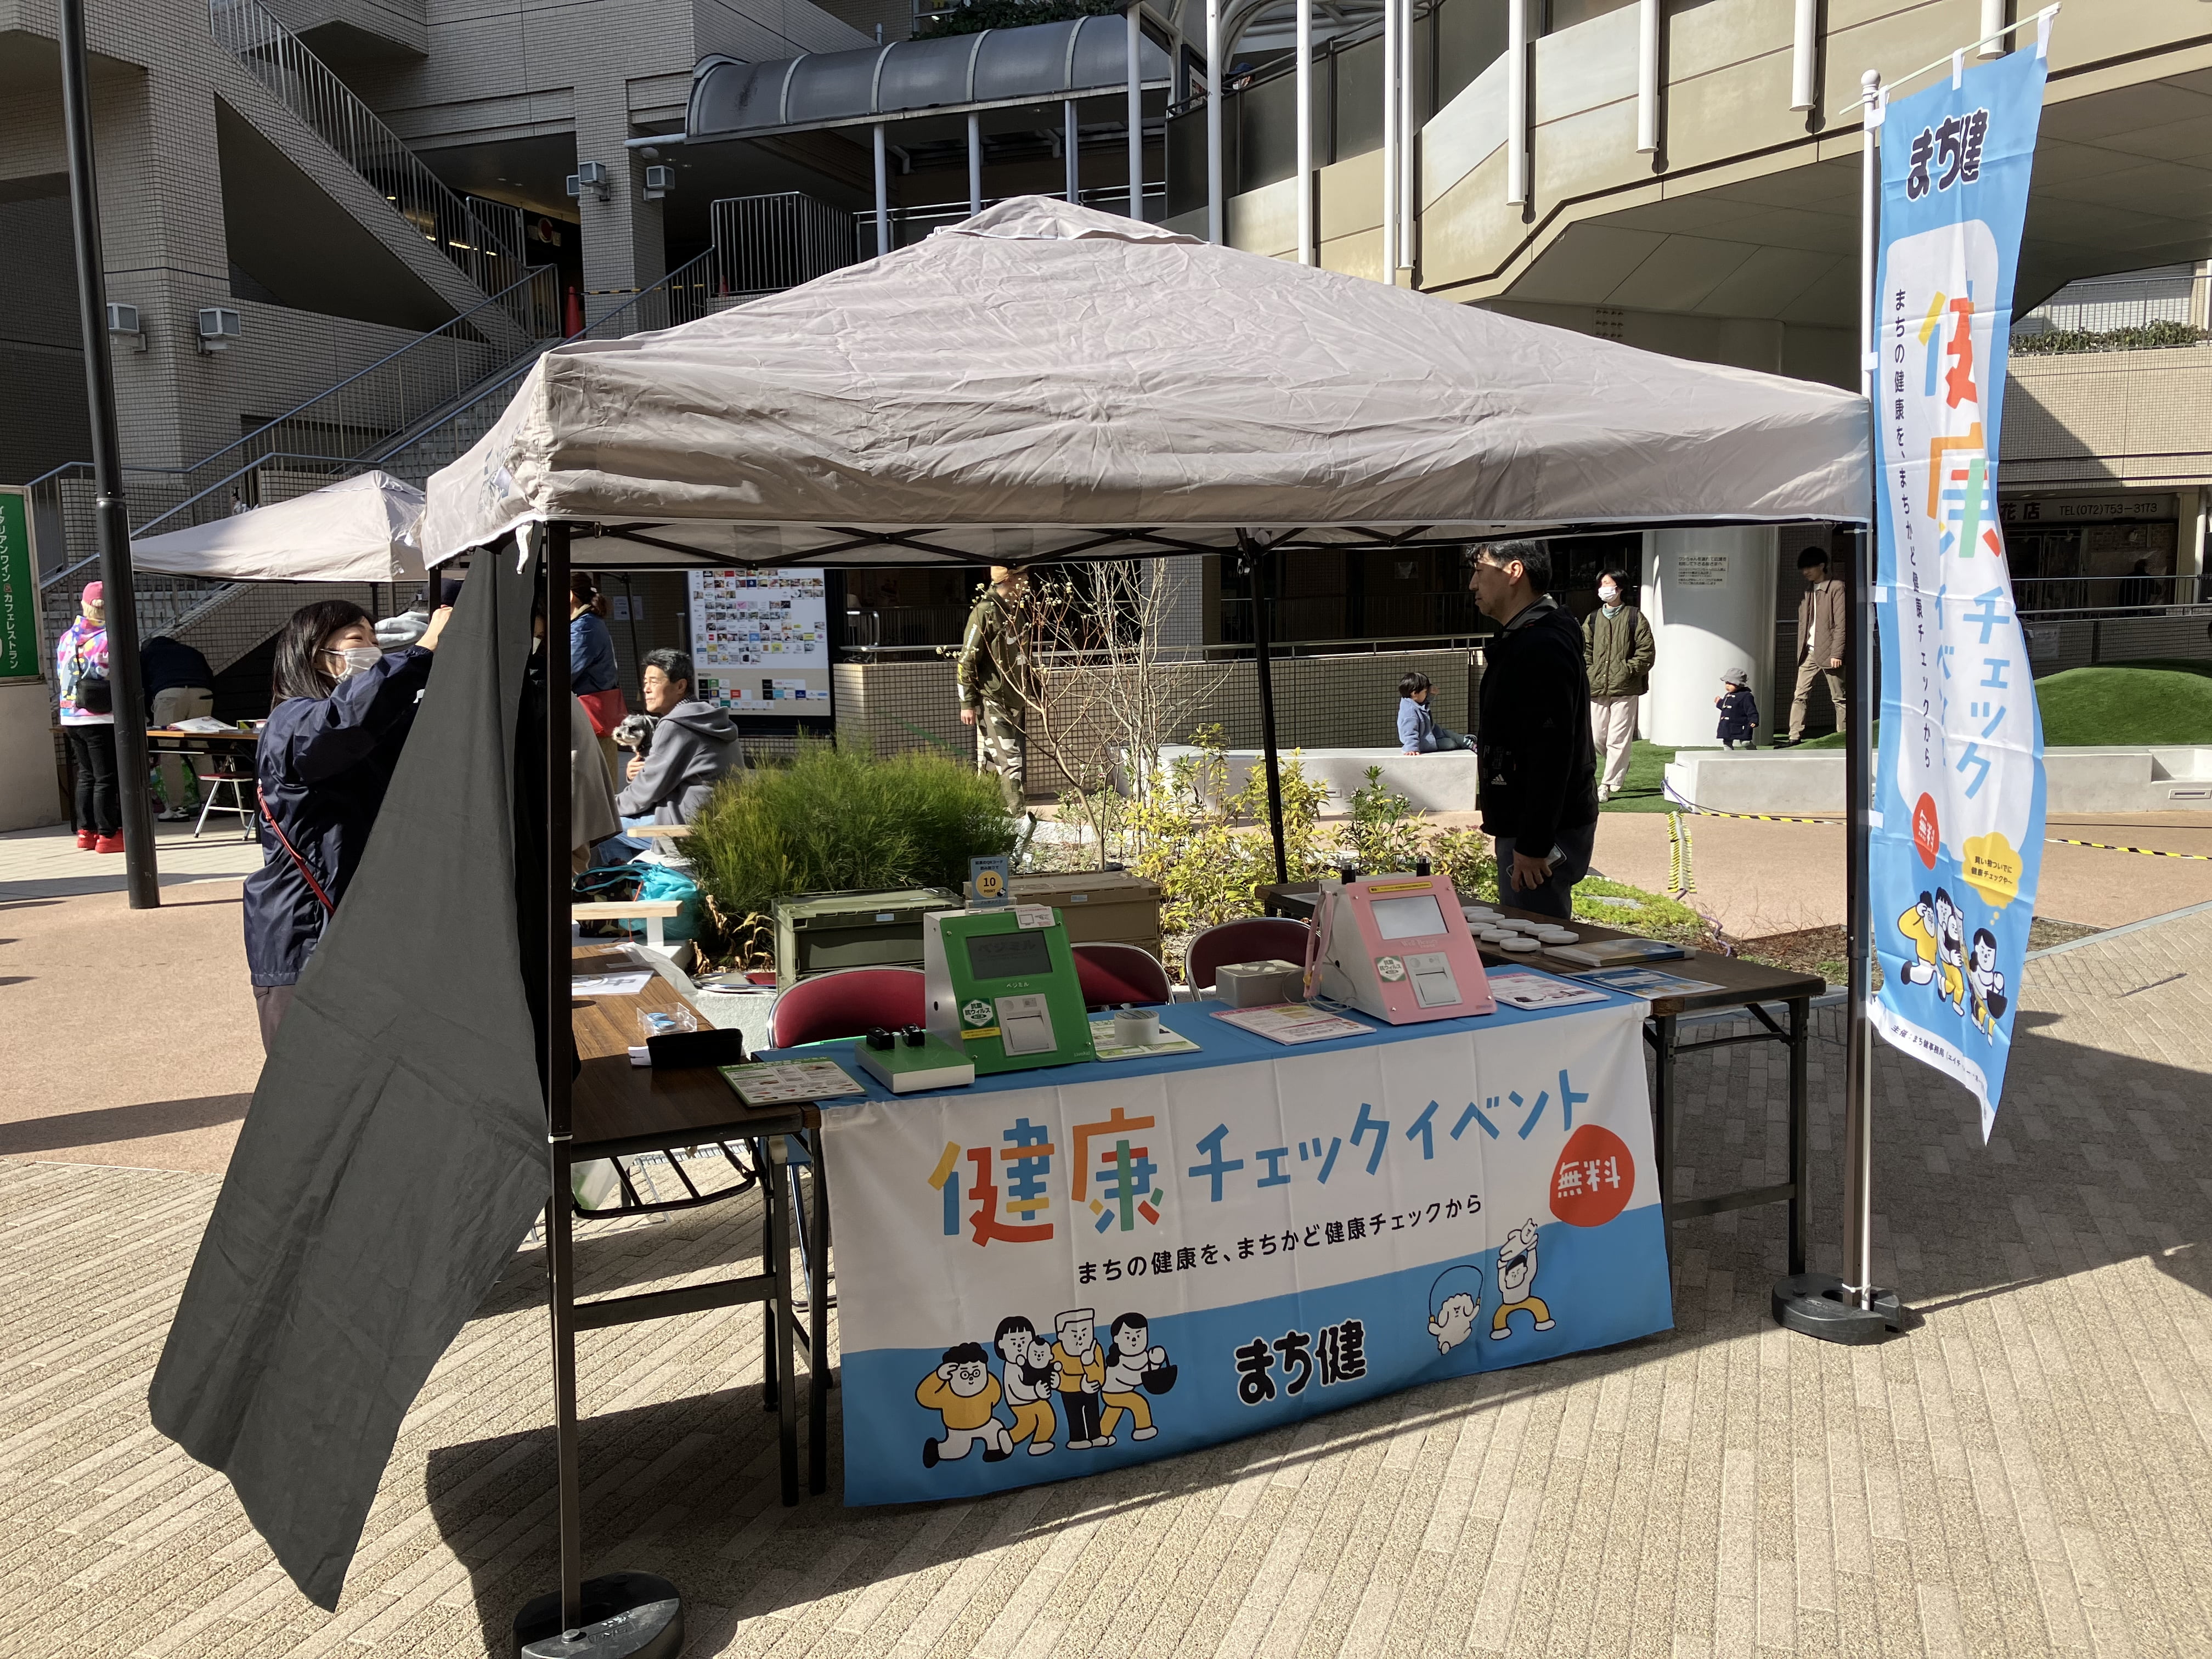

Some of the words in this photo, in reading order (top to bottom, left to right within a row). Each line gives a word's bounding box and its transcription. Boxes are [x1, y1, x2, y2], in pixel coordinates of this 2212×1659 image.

[1906, 109, 1989, 201] まち健
[983, 877, 996, 887] 10
[928, 1069, 1589, 1247] 健康チェックイベント
[1557, 1156, 1621, 1198] 無料
[1078, 1194, 1482, 1285] まちの健康を、まちかど健康チェックから
[1234, 1319, 1367, 1407] まち健
